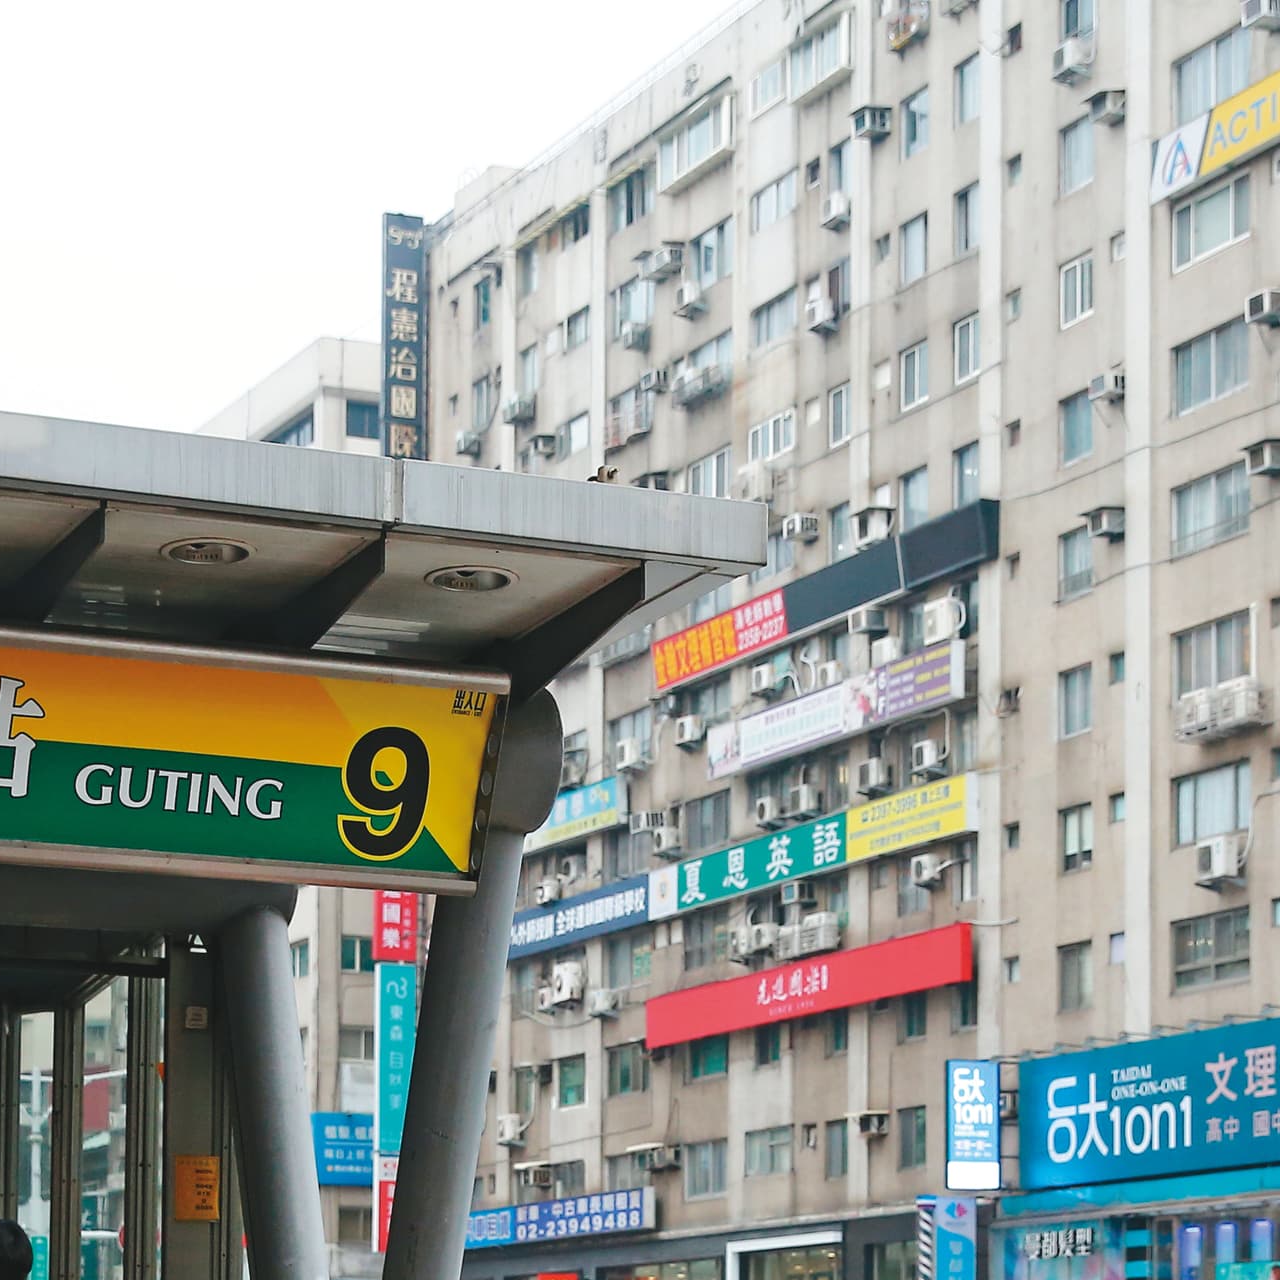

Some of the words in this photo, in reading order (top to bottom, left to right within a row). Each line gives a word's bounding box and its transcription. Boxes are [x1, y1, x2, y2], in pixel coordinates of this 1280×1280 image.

[452, 689, 488, 712] 出入口
[73, 762, 284, 823] GUTING
[337, 725, 431, 862] 9
[681, 823, 843, 905] 夏恩英語
[1205, 1115, 1241, 1143] 高中
[516, 1210, 641, 1241] 02-23949488
[1024, 1227, 1095, 1260] 曼都髮型
